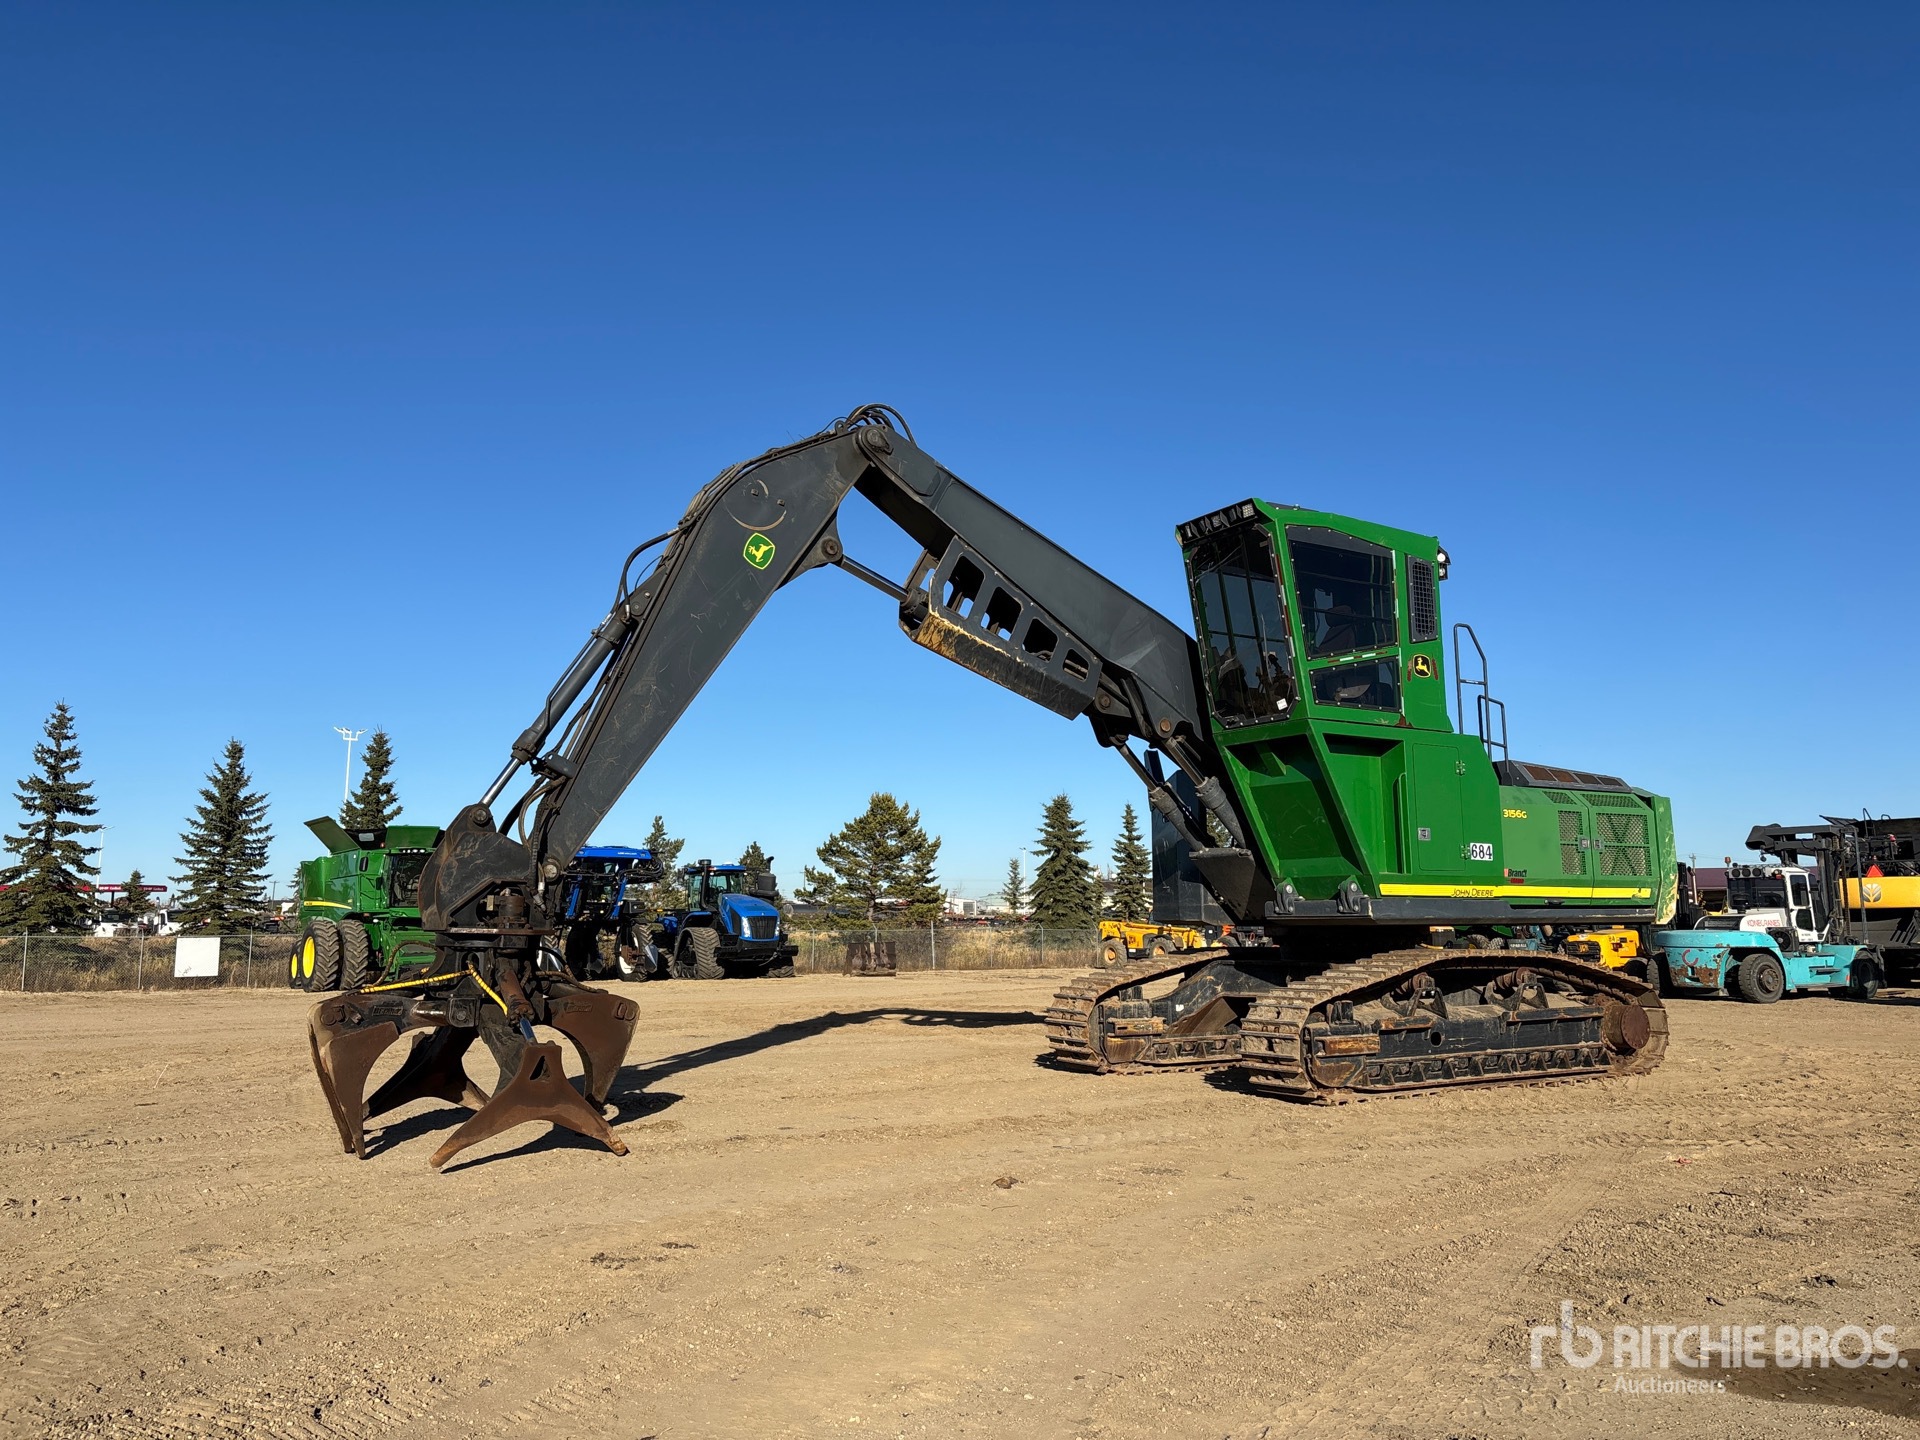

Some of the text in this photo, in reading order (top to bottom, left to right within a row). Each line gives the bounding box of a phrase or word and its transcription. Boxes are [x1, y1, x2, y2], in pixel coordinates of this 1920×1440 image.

[1503, 809, 1527, 819] 3156G
[1471, 843, 1493, 860] 684
[1451, 888, 1494, 896] JOHN DEERE
